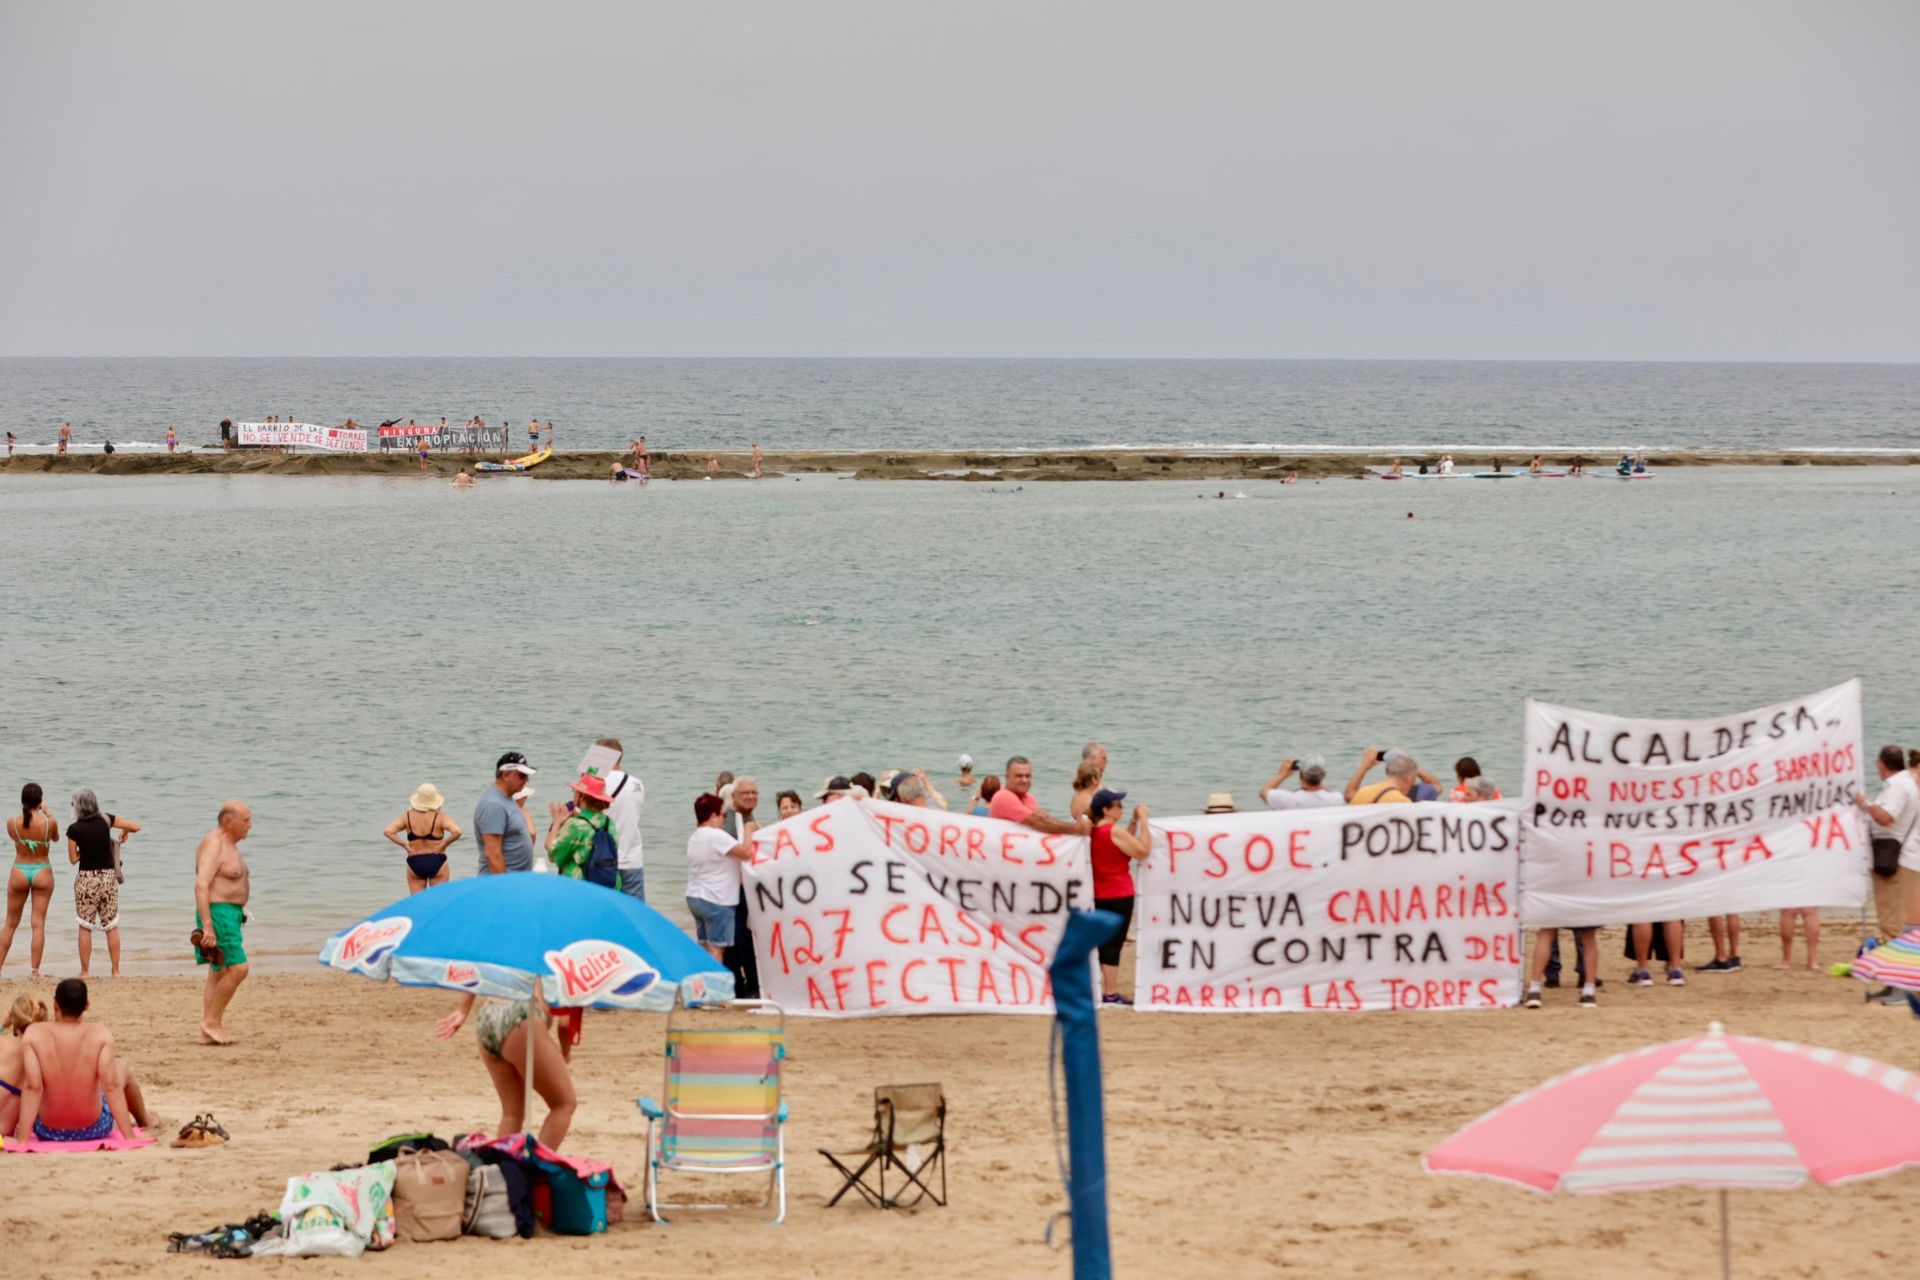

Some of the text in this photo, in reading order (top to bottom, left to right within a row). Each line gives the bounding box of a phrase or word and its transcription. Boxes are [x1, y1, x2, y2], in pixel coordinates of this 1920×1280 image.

[243, 424, 366, 441] EL BARRIO DE LAS TORRES
[243, 433, 365, 451] NO SE VENDE SE DEFIENDE
[383, 426, 438, 437] NINGUNA
[1536, 769, 1591, 802] POR
[1609, 762, 1760, 803] NUESTROS
[1533, 802, 1588, 829] POR
[1603, 798, 1756, 830] NUESTRAS
[750, 814, 835, 867] LAS
[755, 874, 818, 913] NO
[849, 859, 907, 895] SE
[770, 903, 1049, 975] 127 CASAS
[1161, 931, 1521, 970] EN CONTRA DEL
[553, 949, 621, 997] Kalise
[1303, 978, 1364, 1011] LAS
